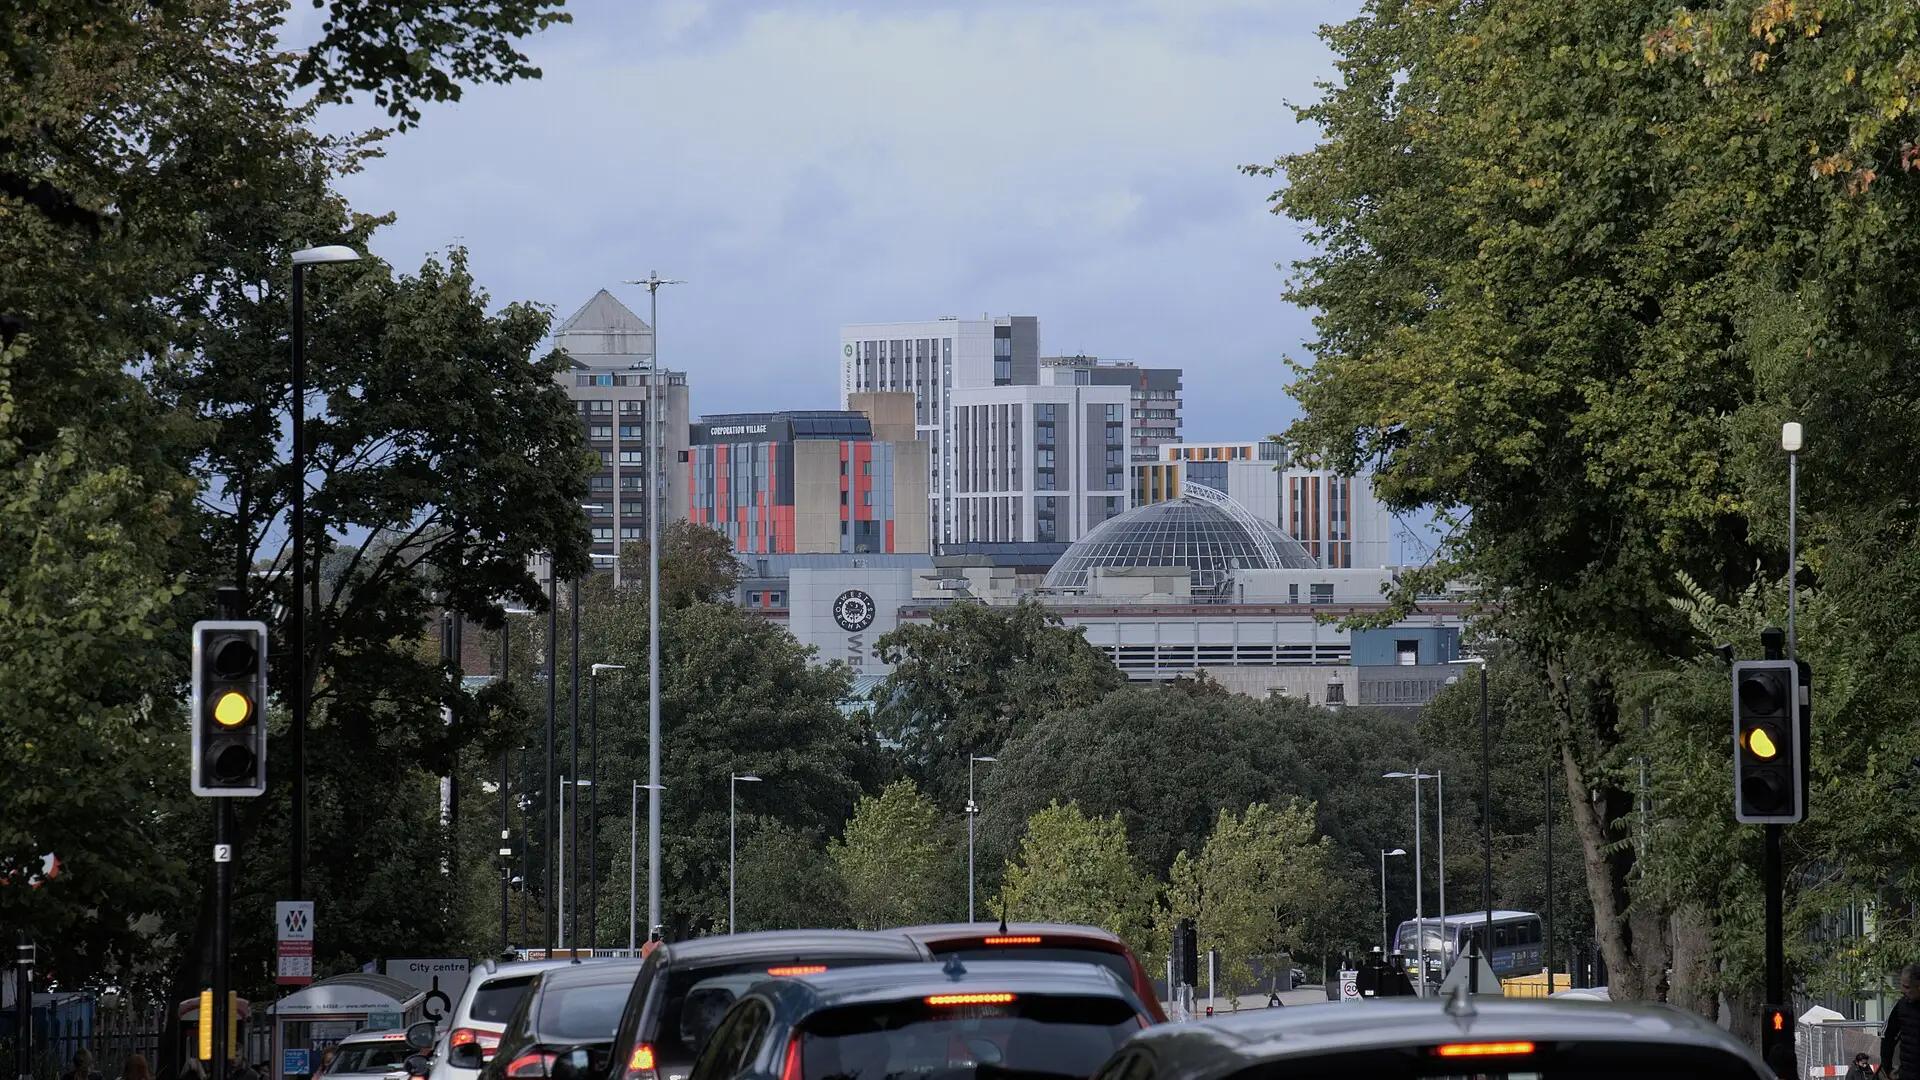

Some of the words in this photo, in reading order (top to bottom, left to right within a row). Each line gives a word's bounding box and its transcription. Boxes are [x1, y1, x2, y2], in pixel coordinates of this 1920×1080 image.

[710, 425, 745, 435] CORPORATION
[745, 424, 767, 434] VILLAGE
[840, 591, 869, 602] WEST
[835, 606, 873, 629] ORCHARDS
[219, 847, 228, 859] 2
[409, 963, 429, 973] City
[433, 963, 465, 971] centre
